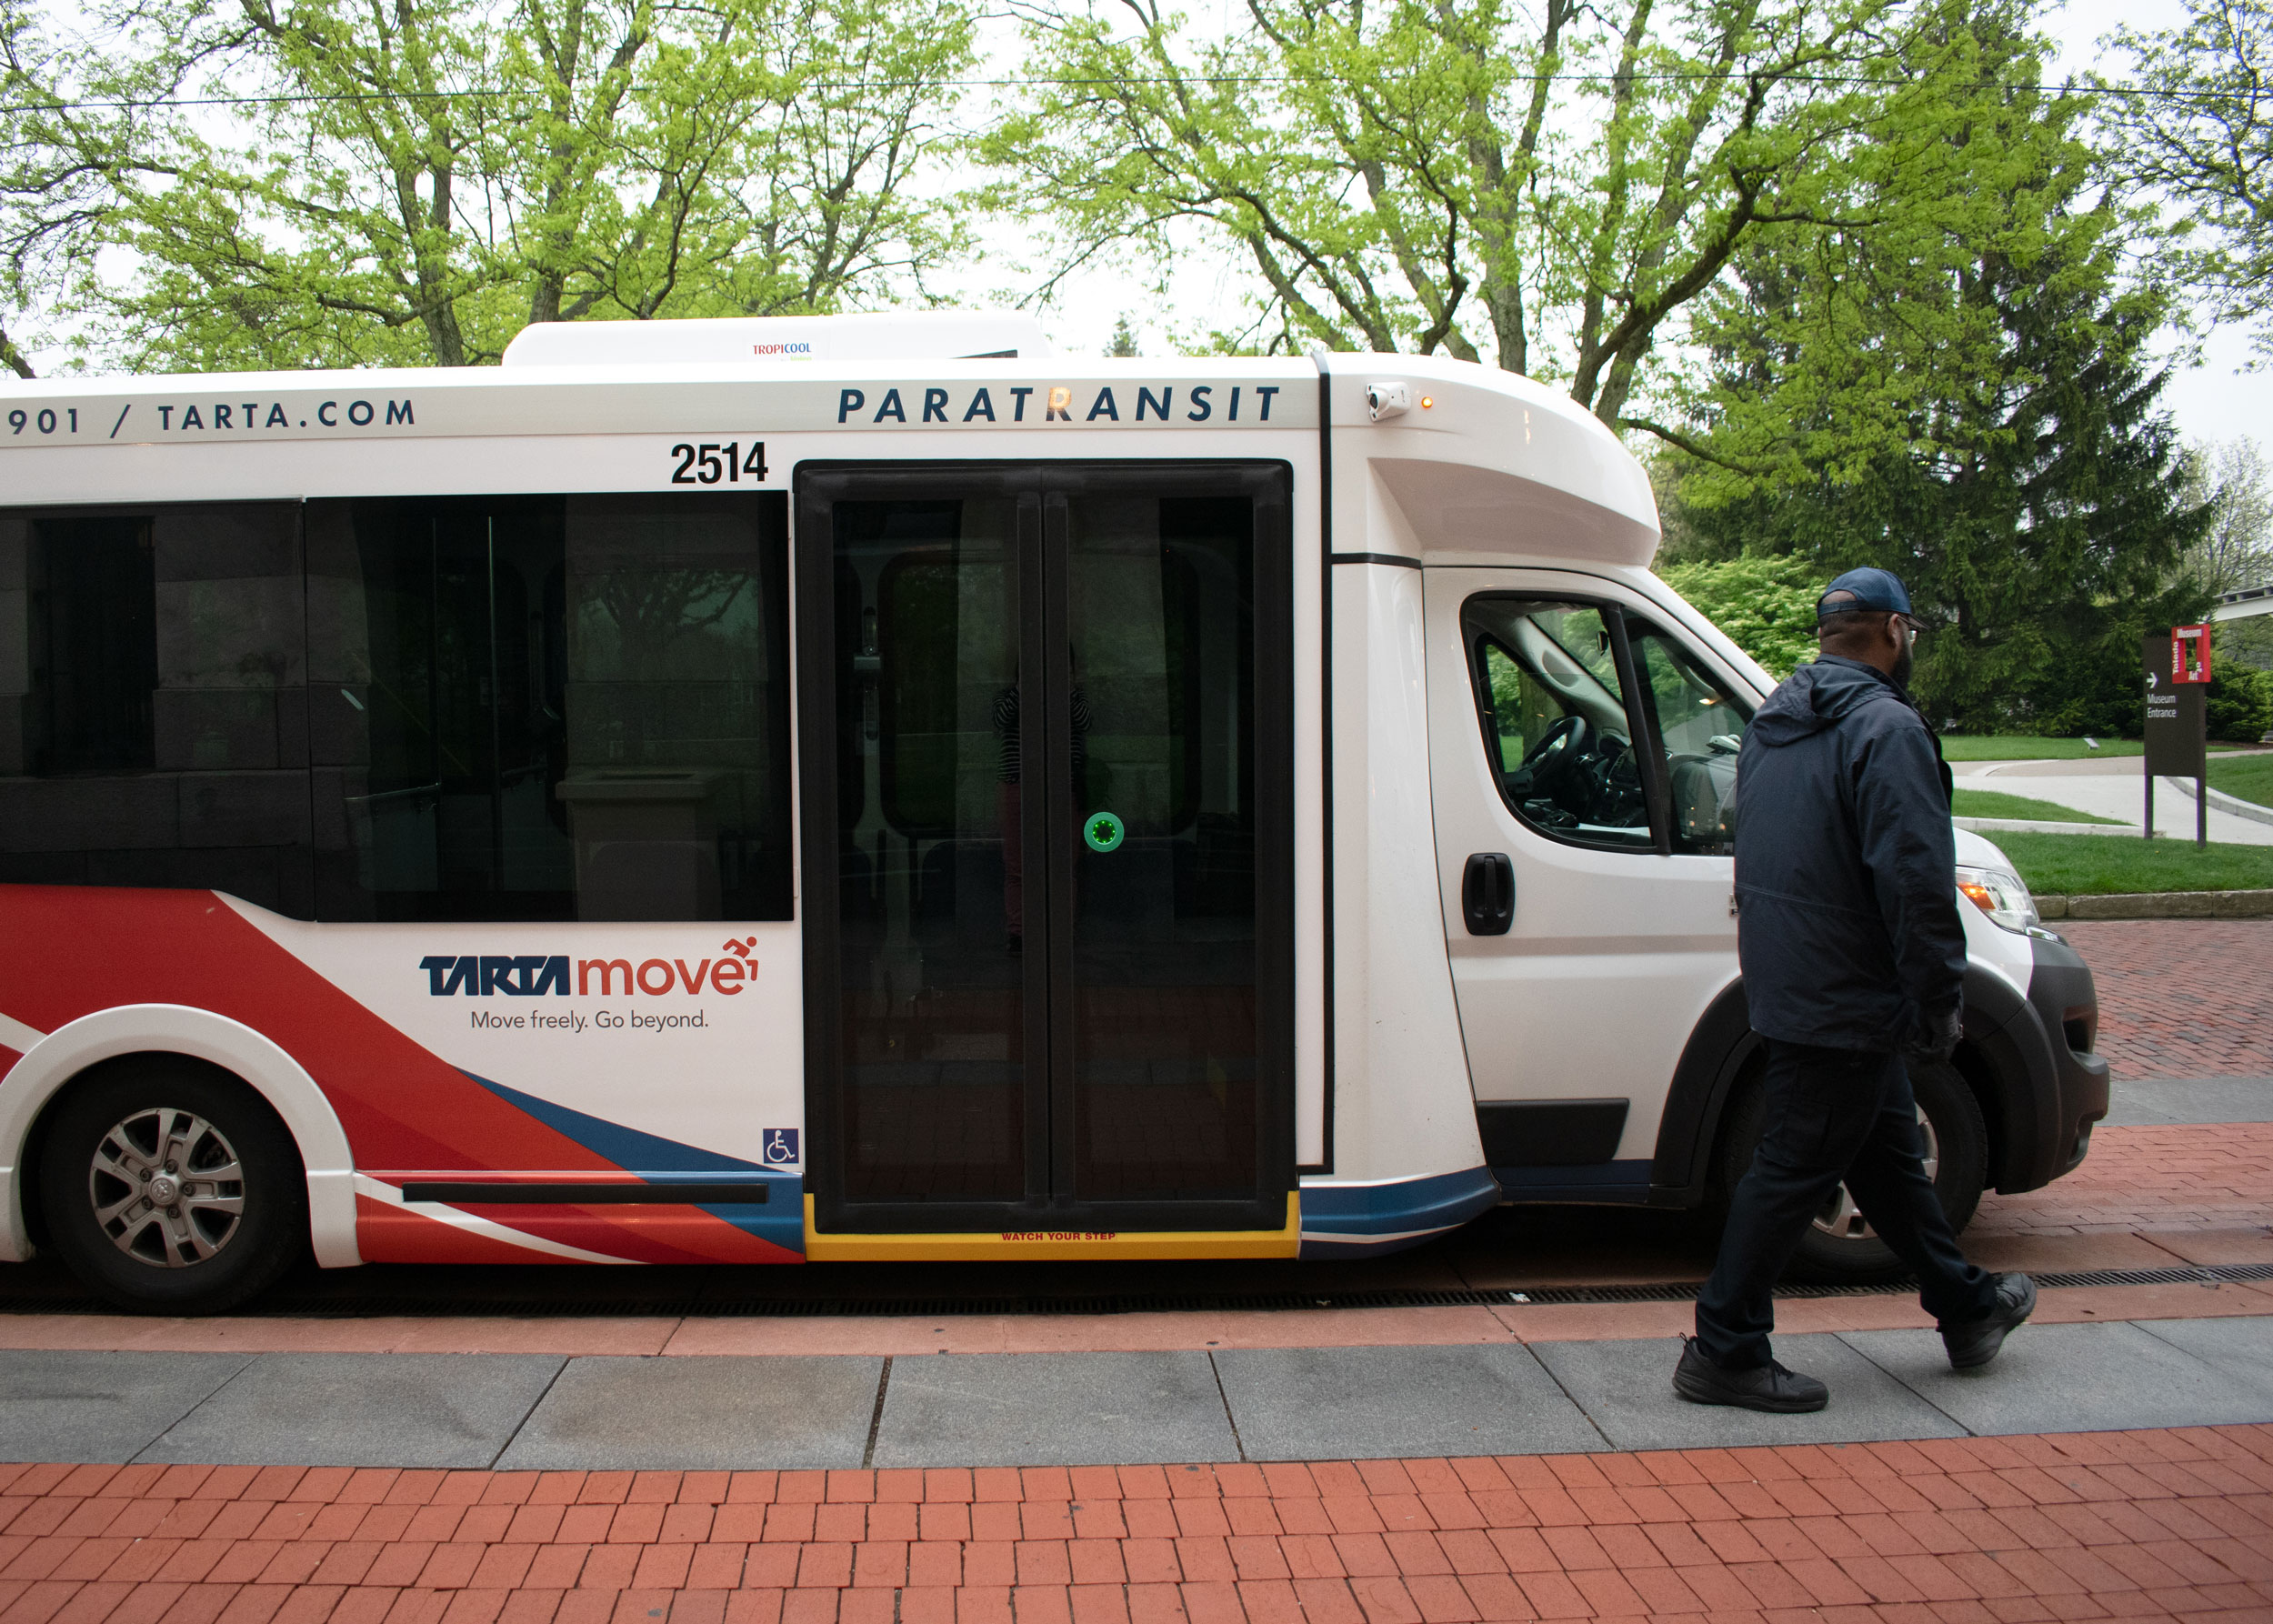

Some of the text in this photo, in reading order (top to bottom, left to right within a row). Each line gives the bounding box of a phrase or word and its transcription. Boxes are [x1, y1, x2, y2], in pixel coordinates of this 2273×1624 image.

[753, 343, 812, 355] TROPICOOL
[836, 386, 1280, 424] PARATRANSIT
[7, 407, 79, 436] 901
[157, 399, 416, 431] TARTA.COM
[670, 441, 769, 485] 2514
[2177, 628, 2201, 638] Museum
[2147, 694, 2175, 704] Museum
[2147, 707, 2177, 718] Entrance
[471, 1009, 709, 1034] Move freely. Go beyond.
[1002, 1232, 1116, 1241] WATCH YOUR STEP
